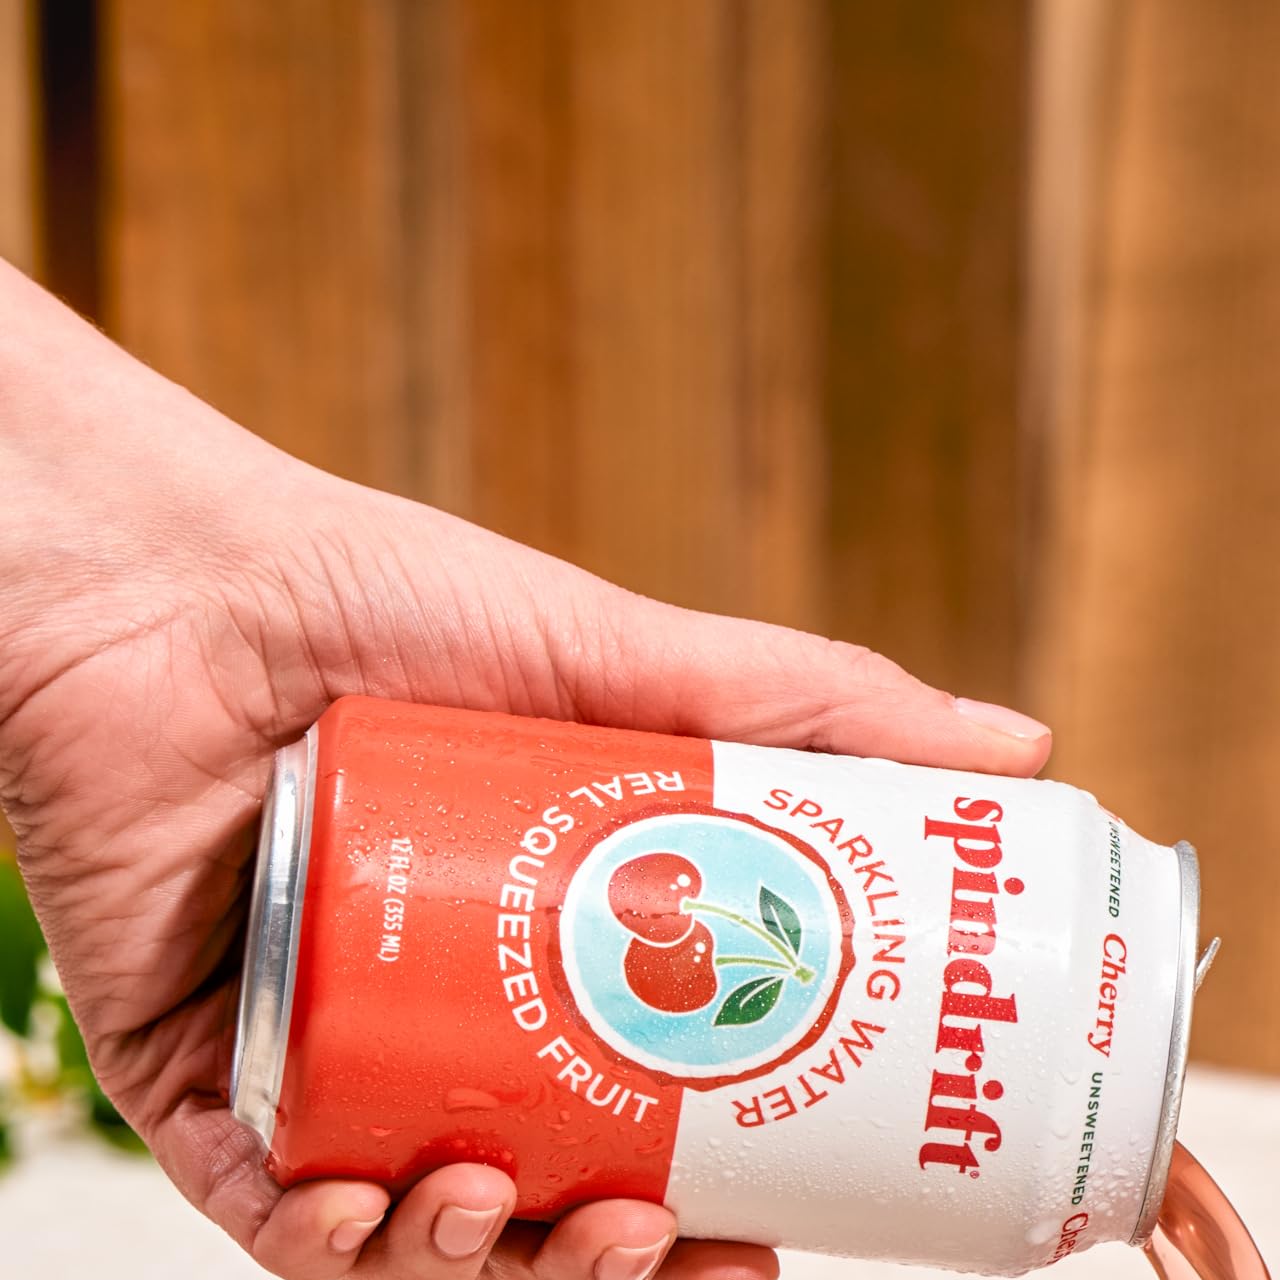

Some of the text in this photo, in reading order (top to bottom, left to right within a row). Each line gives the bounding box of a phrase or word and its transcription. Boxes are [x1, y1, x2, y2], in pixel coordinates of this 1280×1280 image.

[386, 874, 407, 894] OZ
[391, 837, 413, 856] 12
[376, 933, 401, 962] ML)
[383, 898, 405, 931] (355
[497, 770, 686, 1123] REAL SQUEEZED FRUIT
[731, 788, 907, 1128] SPARKLING WATER
[918, 796, 1025, 1173] spindrift
[1087, 933, 1128, 1058] Cherry
[1071, 1072, 1104, 1206] UNSWEETENED
